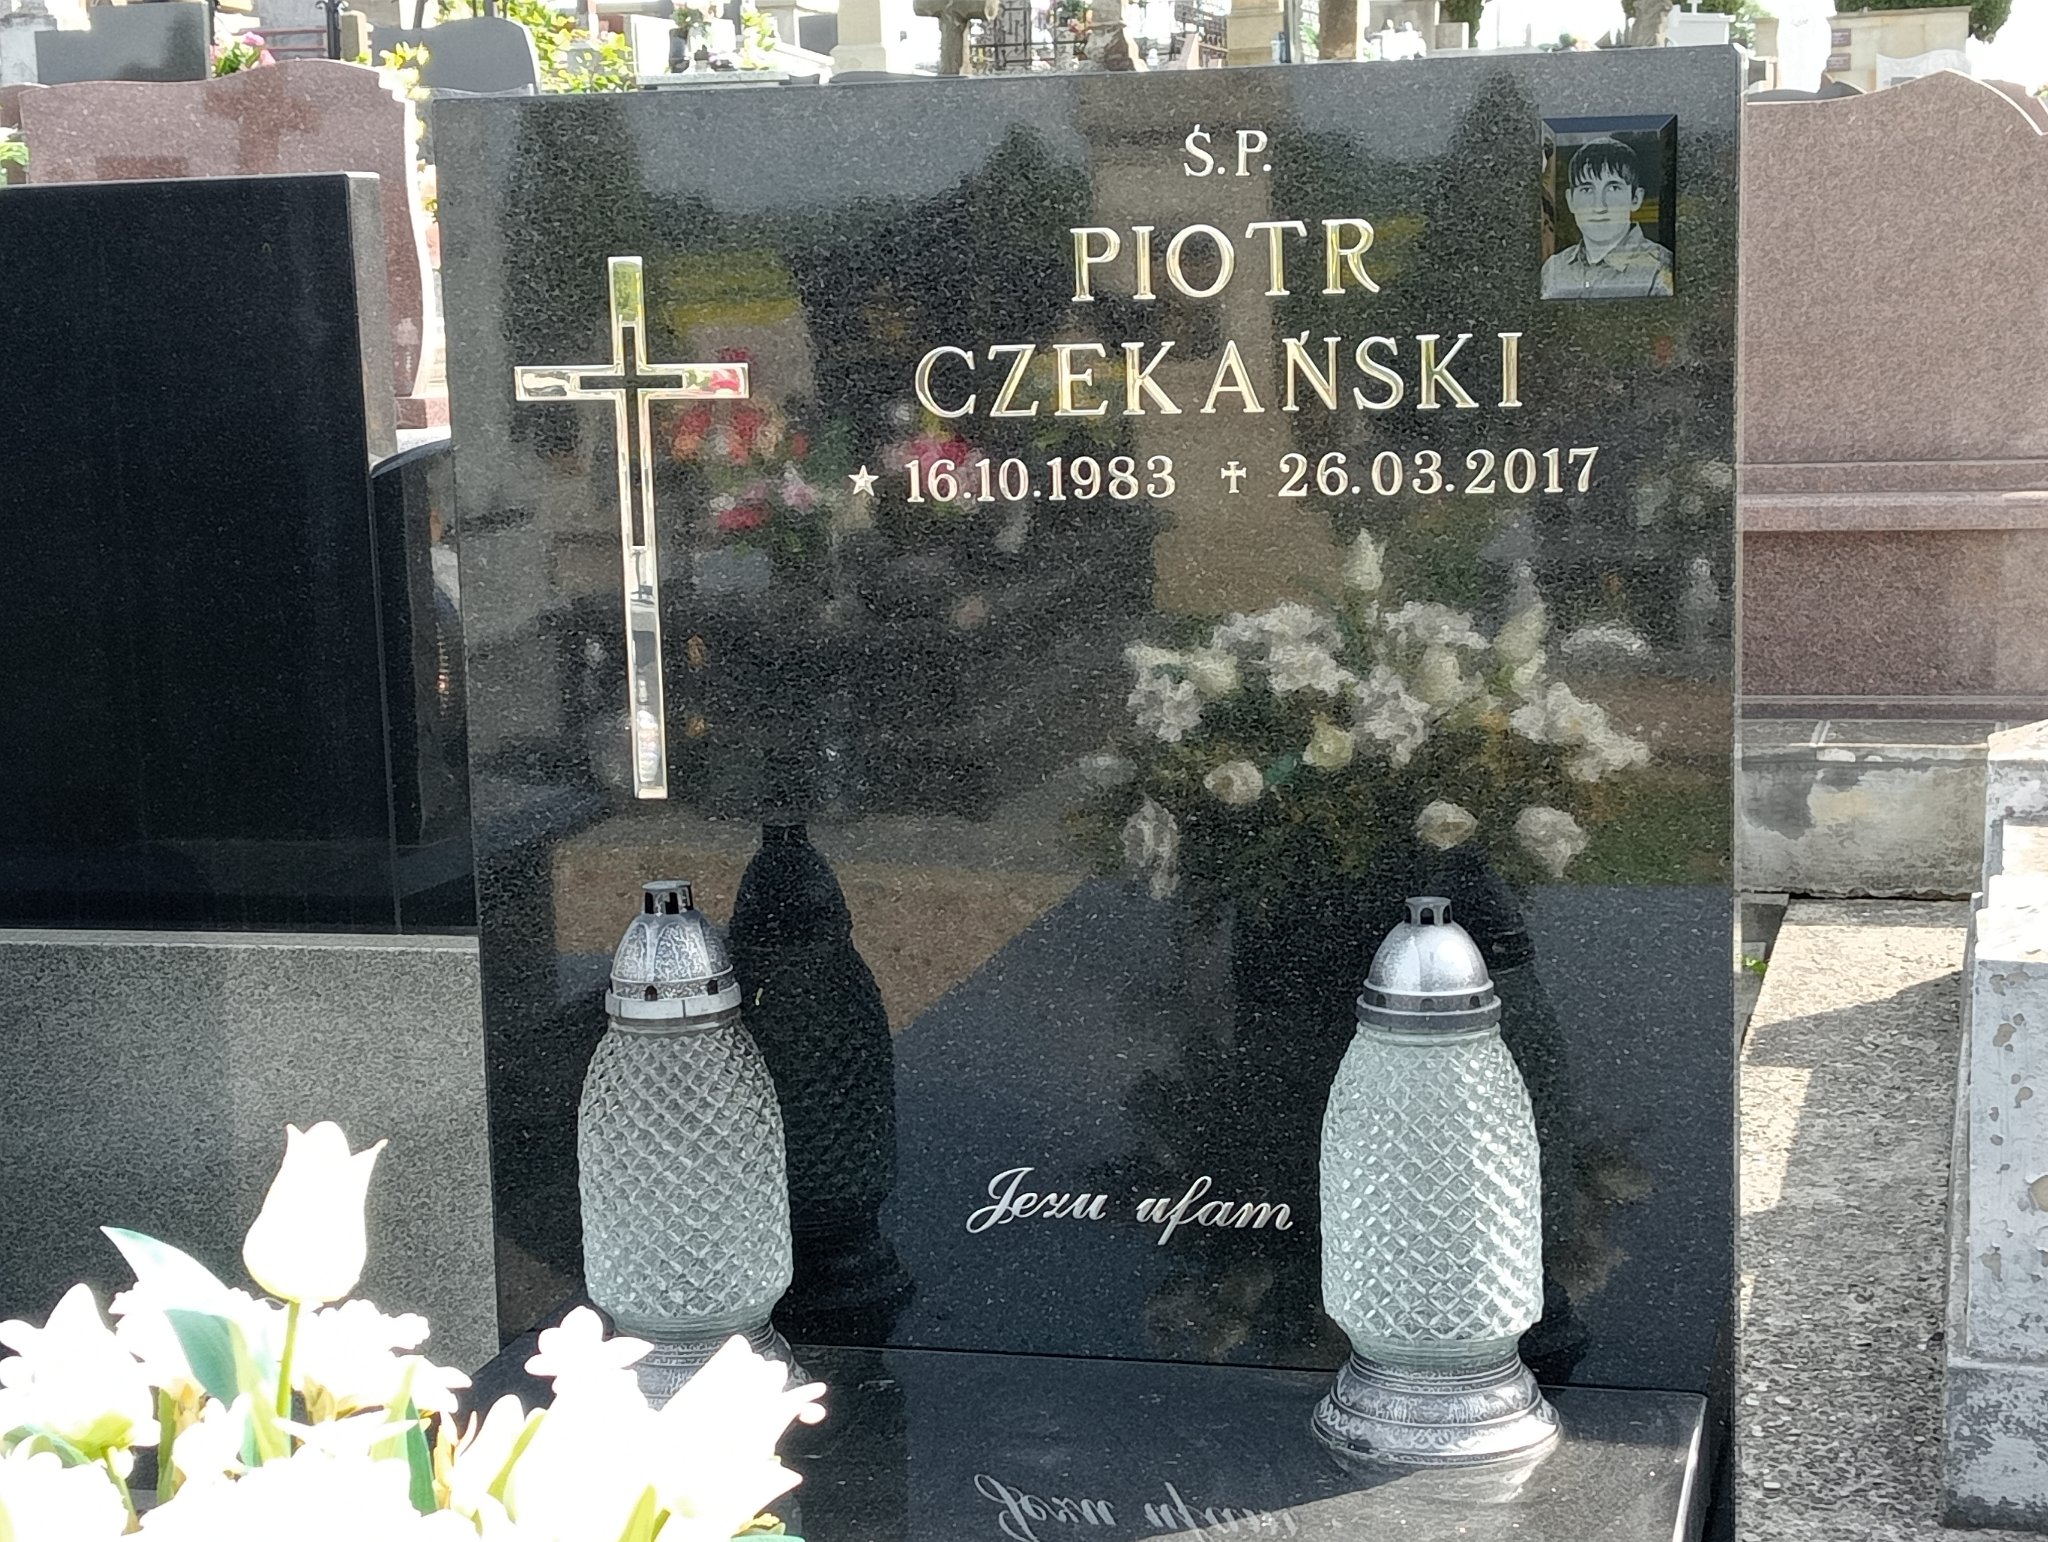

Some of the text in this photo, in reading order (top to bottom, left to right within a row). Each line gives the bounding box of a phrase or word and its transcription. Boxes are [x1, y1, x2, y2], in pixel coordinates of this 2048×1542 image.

[1069, 217, 1381, 303] PIOTR
[914, 329, 1524, 419] CZEKAŃSKI
[904, 445, 1600, 504] 16.10.1983 26.03.2017
[965, 1166, 1294, 1246] Jezu ufam
